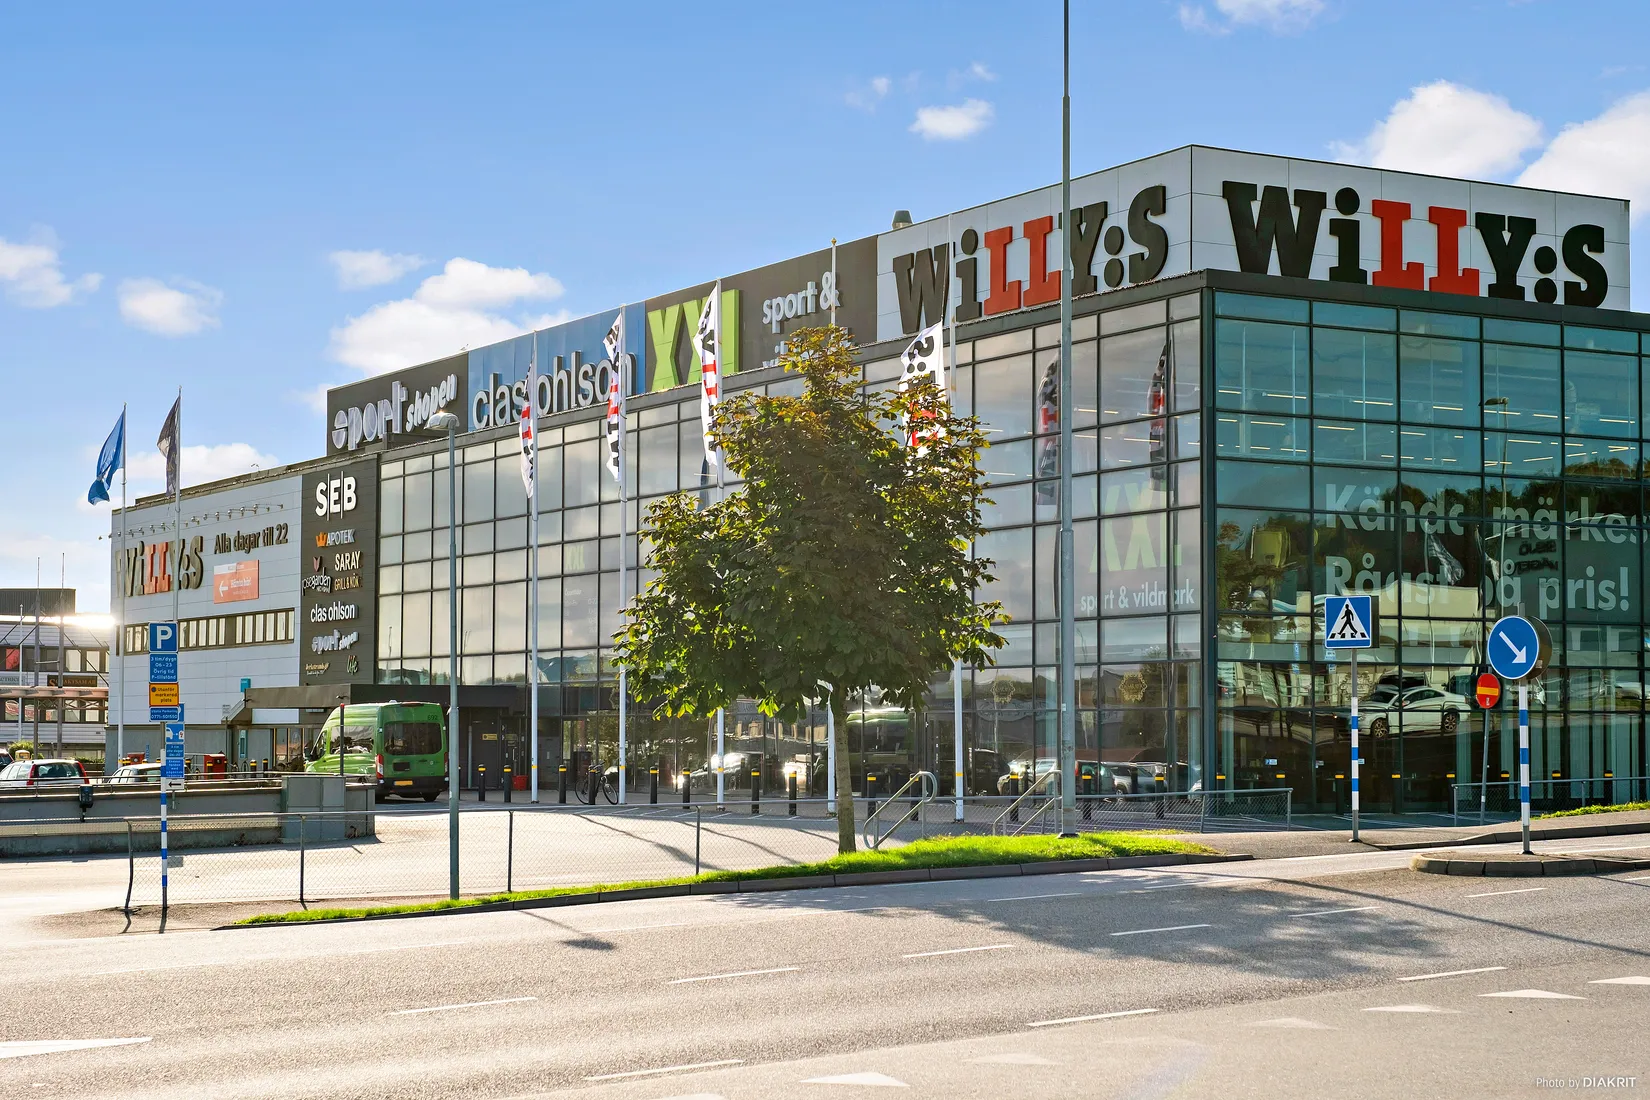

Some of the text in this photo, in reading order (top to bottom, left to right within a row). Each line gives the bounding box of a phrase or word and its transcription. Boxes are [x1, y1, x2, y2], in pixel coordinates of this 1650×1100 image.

[762, 271, 841, 334] sport &
[473, 372, 530, 432] clas
[537, 351, 637, 418] ohlson
[315, 475, 357, 518] SEB
[214, 522, 289, 555] Alla dagar till 22
[327, 528, 356, 547] APOTEK
[334, 550, 361, 572] SARAY
[1118, 585, 1129, 609] &
[1538, 565, 1630, 620] pris!
[310, 600, 356, 623] clas ohlson
[156, 625, 173, 649] P
